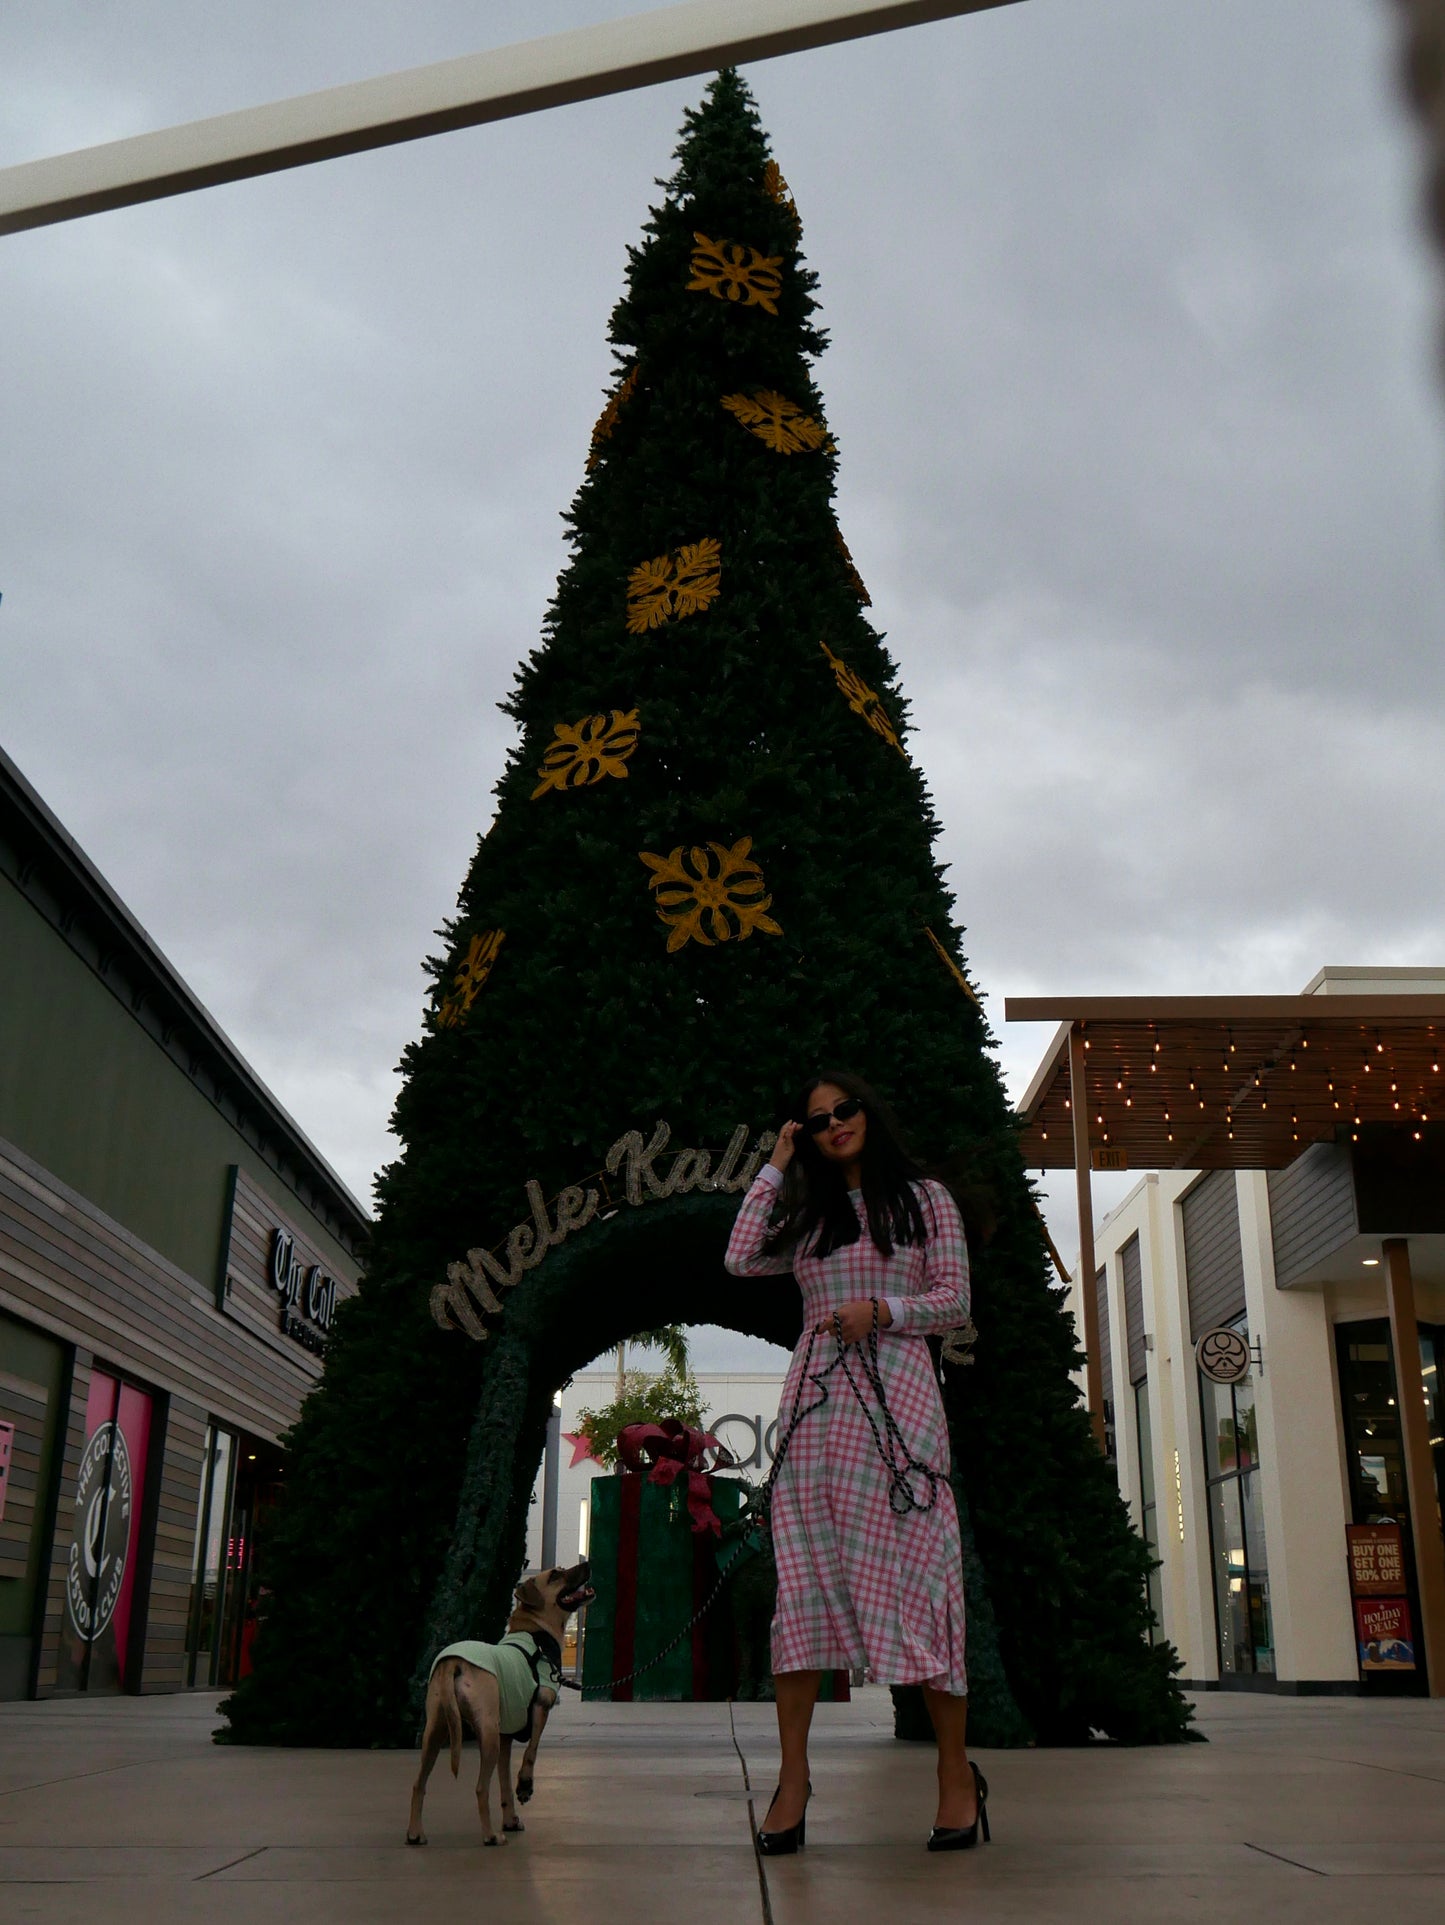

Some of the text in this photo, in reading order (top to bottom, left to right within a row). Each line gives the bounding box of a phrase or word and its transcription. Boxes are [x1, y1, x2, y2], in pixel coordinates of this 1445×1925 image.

[1099, 1151, 1121, 1167] EXIT
[428, 1178, 601, 1342] Mele
[271, 1229, 304, 1311] The
[75, 1433, 130, 1520] THE COLECTIVE
[1353, 1544, 1399, 1557] BUY ONE
[1354, 1556, 1401, 1569] GET ONE
[1356, 1569, 1402, 1581] 50% OFF
[101, 1556, 123, 1618] CLUB
[1364, 1608, 1401, 1625] HOLIDAY
[1368, 1618, 1400, 1635] DEALS
